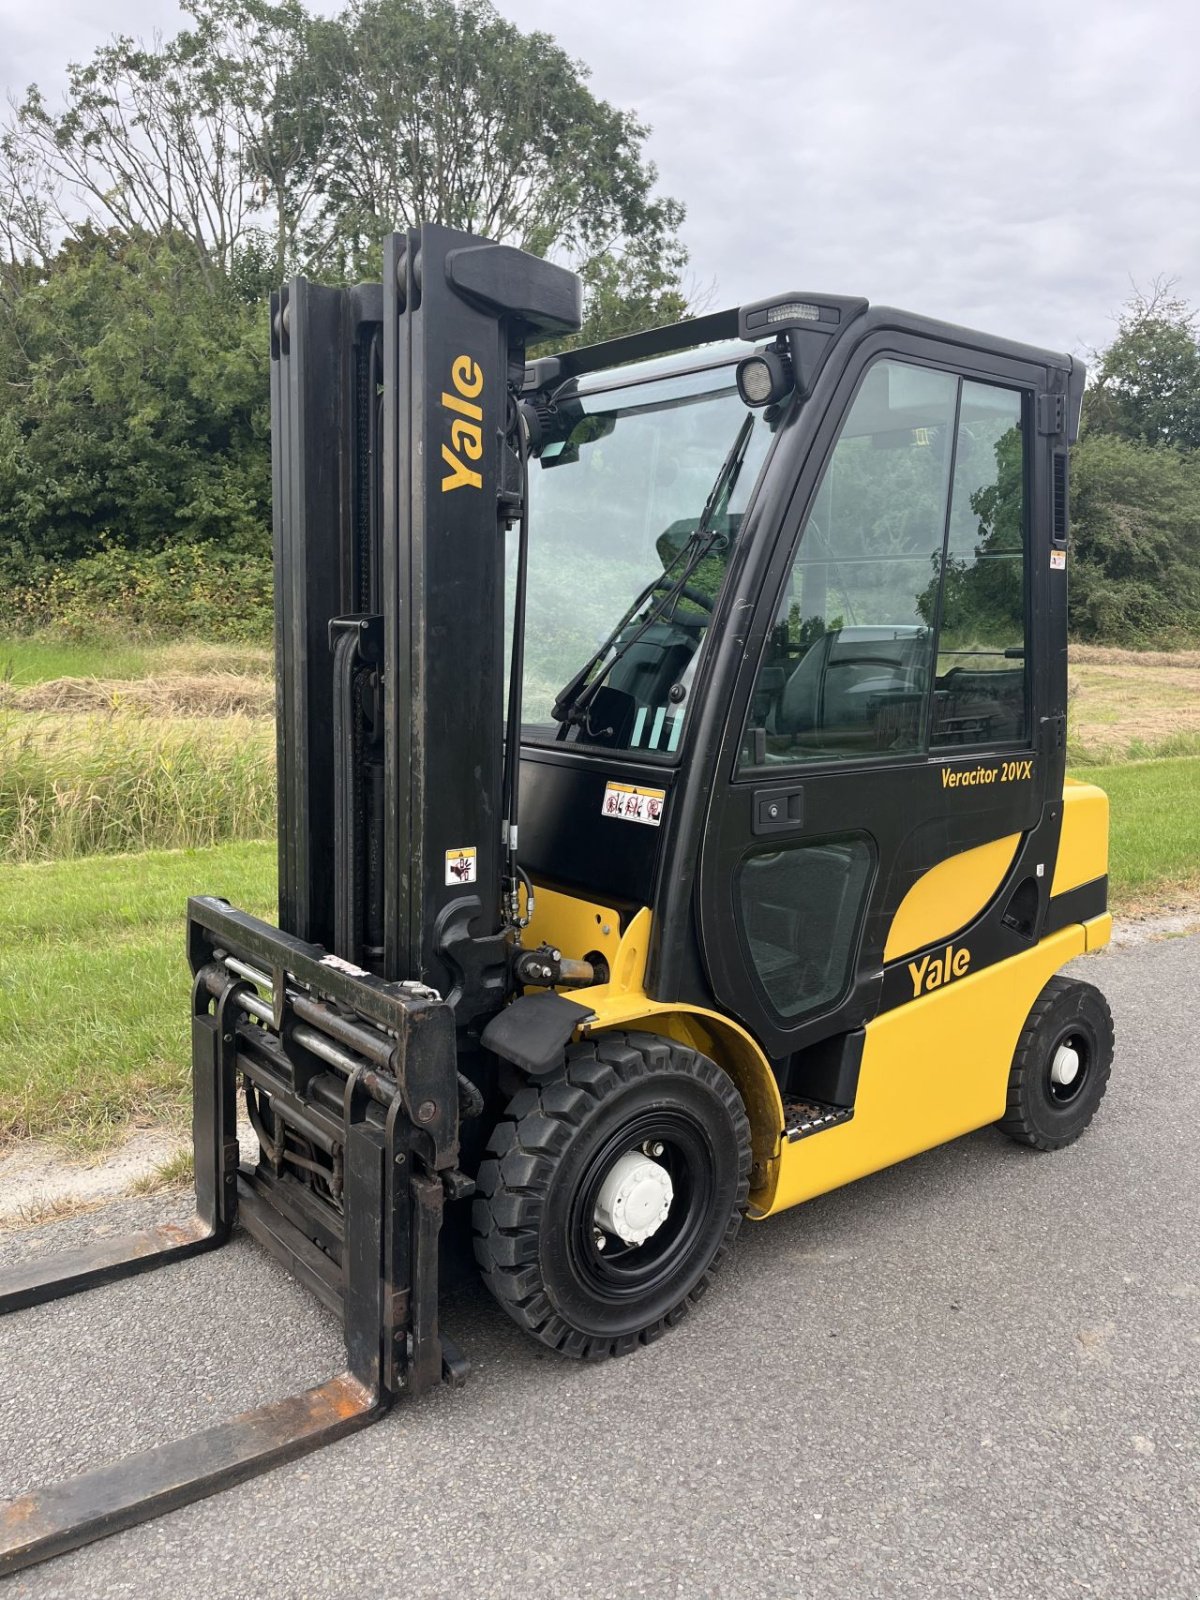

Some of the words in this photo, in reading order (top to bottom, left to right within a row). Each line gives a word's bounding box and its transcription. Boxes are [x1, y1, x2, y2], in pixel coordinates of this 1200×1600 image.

[441, 355, 484, 492] Yale
[942, 766, 998, 788] Veracitor
[1001, 761, 1033, 782] 20VX
[908, 945, 971, 998] Yale
